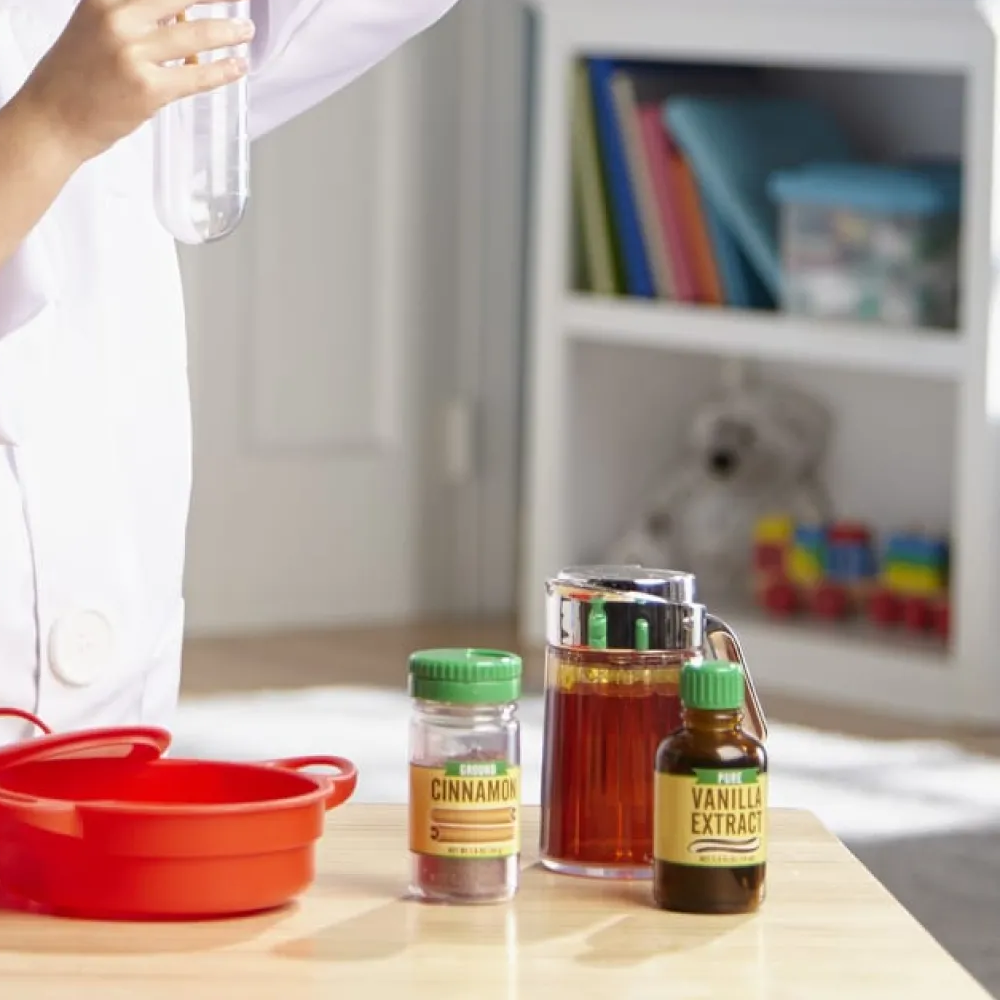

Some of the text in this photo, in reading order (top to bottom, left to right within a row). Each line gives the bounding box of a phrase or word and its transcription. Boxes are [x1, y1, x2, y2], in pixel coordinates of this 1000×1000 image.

[431, 777, 517, 802] CINNAMON
[691, 786, 762, 810] VANILLA
[691, 811, 762, 835] EXTRACT
